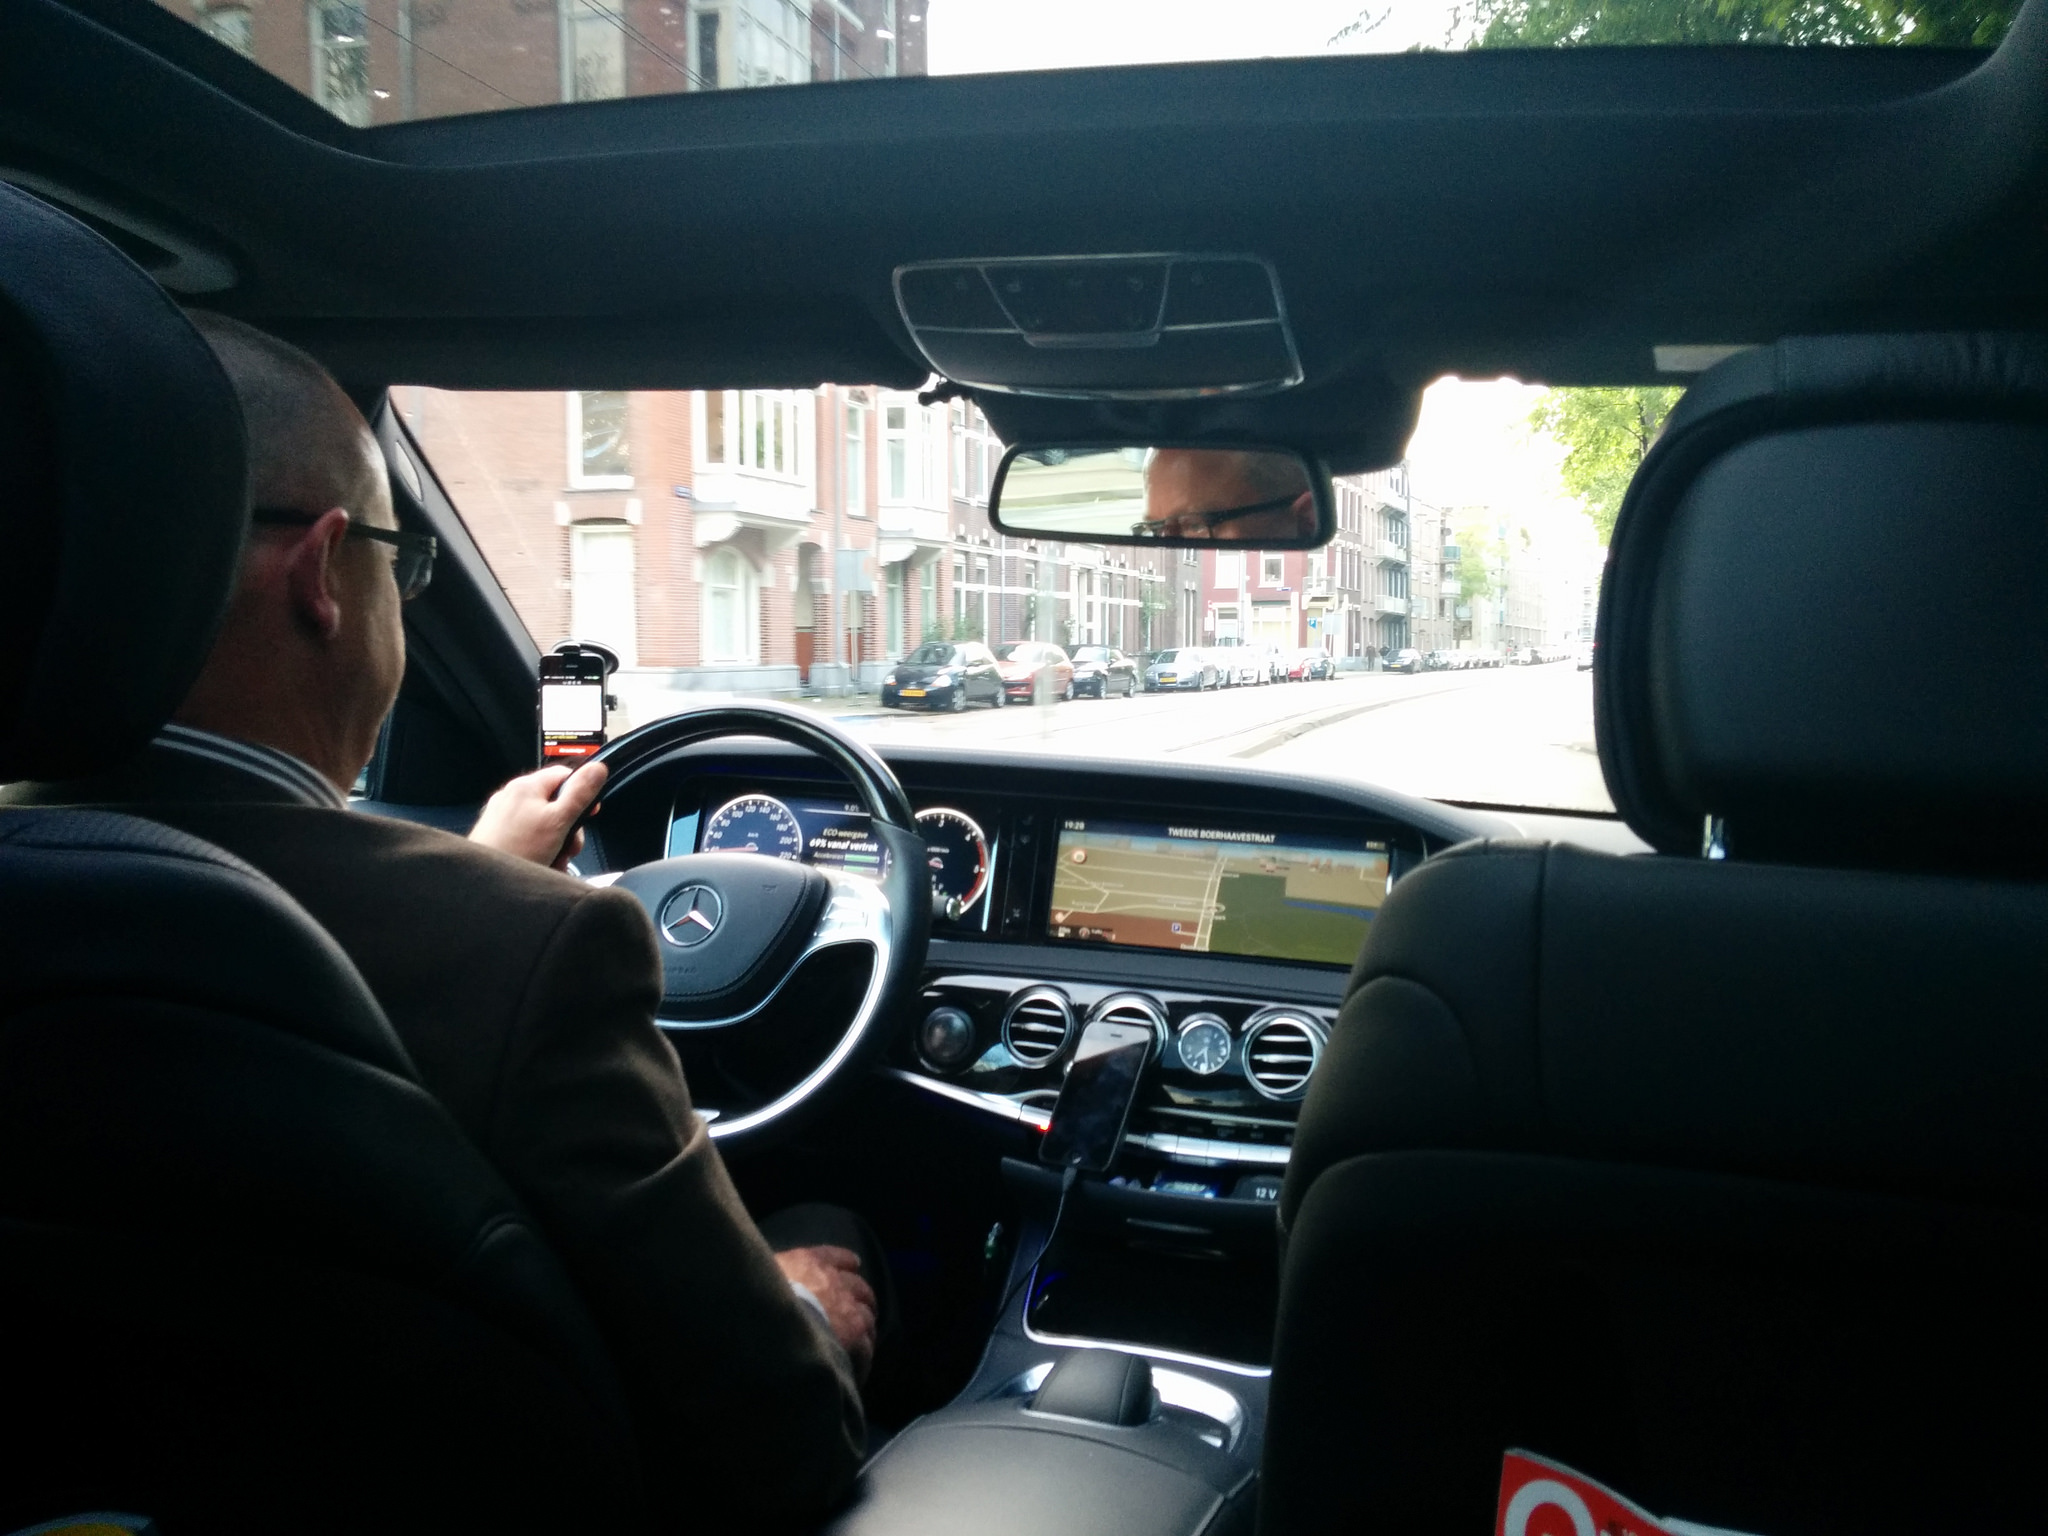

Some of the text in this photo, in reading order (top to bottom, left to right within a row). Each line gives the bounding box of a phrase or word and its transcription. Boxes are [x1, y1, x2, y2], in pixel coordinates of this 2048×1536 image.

[745, 805, 757, 813] 120
[822, 827, 838, 837] ECO
[1168, 827, 1275, 843] TWEEDE BOERHAAVESTRAAT
[809, 838, 879, 852] 69% vanaf vertrek
[1256, 1187, 1278, 1199] 12 V
